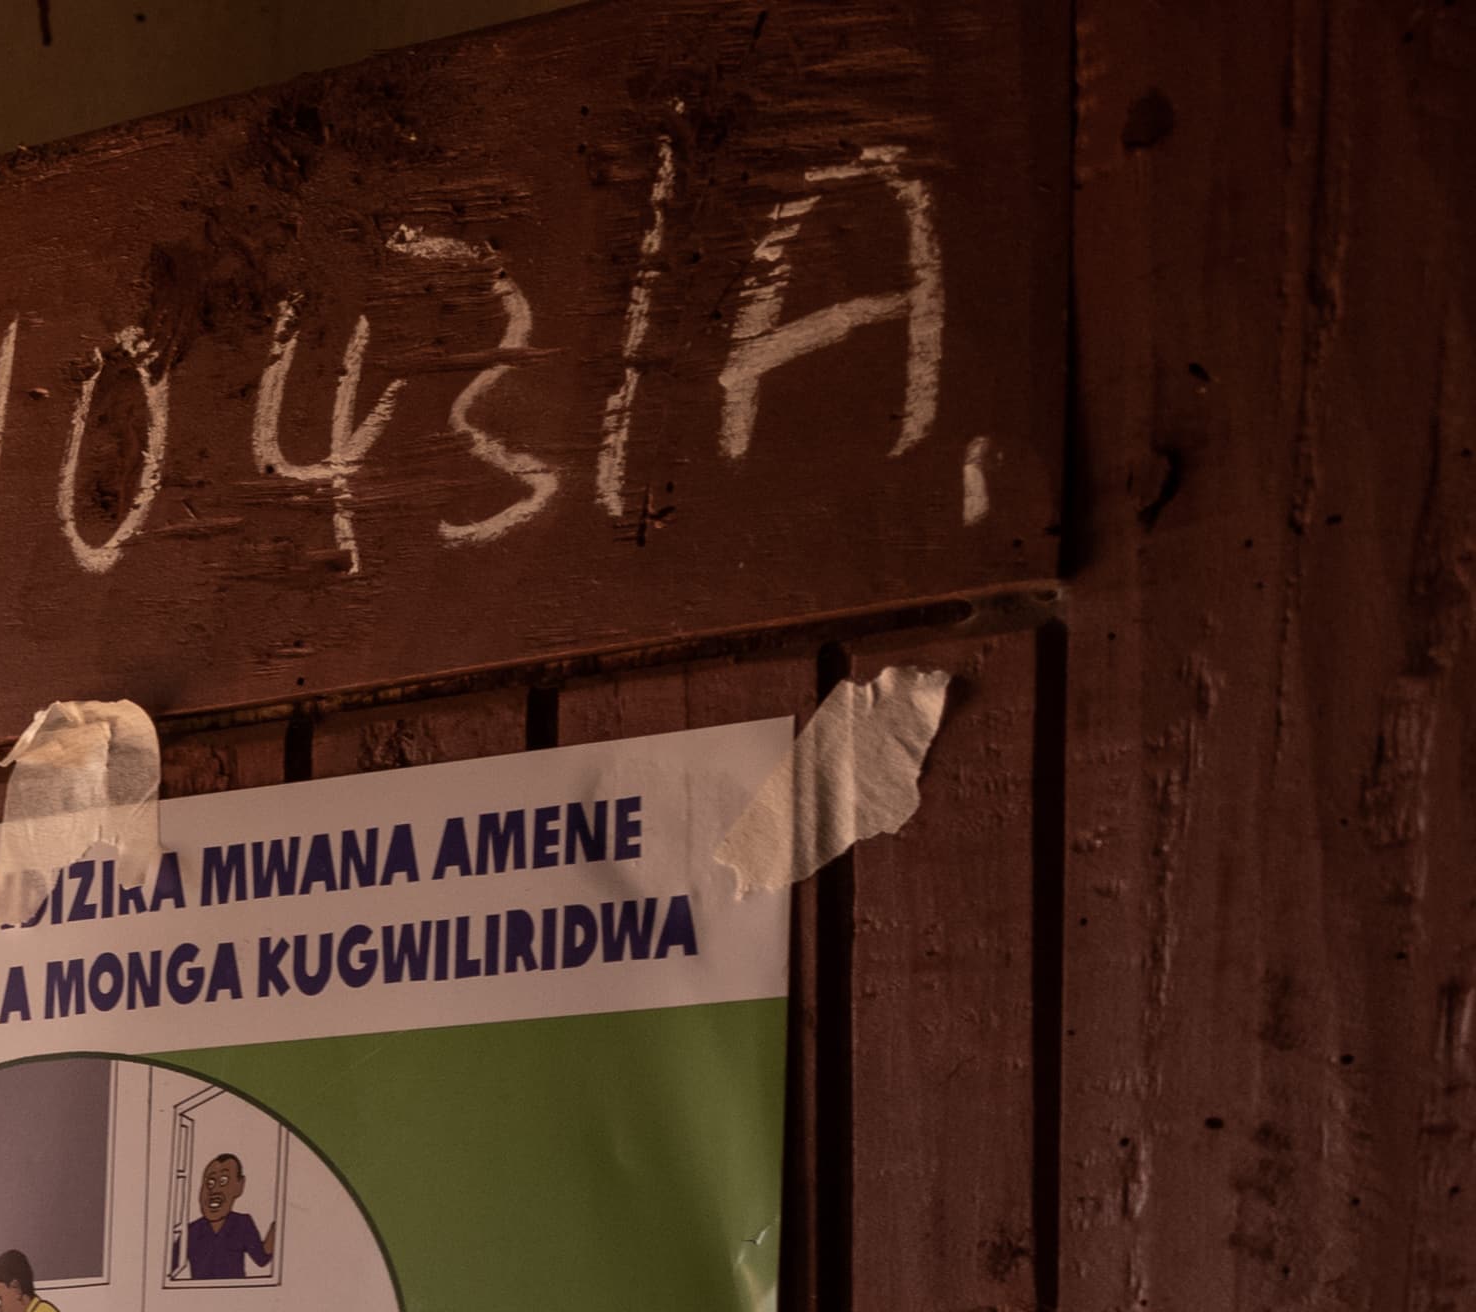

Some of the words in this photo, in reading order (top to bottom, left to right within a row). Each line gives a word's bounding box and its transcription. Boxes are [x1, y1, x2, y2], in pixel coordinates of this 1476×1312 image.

[200, 824, 420, 906] MWANA
[432, 795, 643, 880] AMENE
[43, 941, 243, 1019] MONGA
[258, 895, 699, 999] KUGWILIRIDWA
